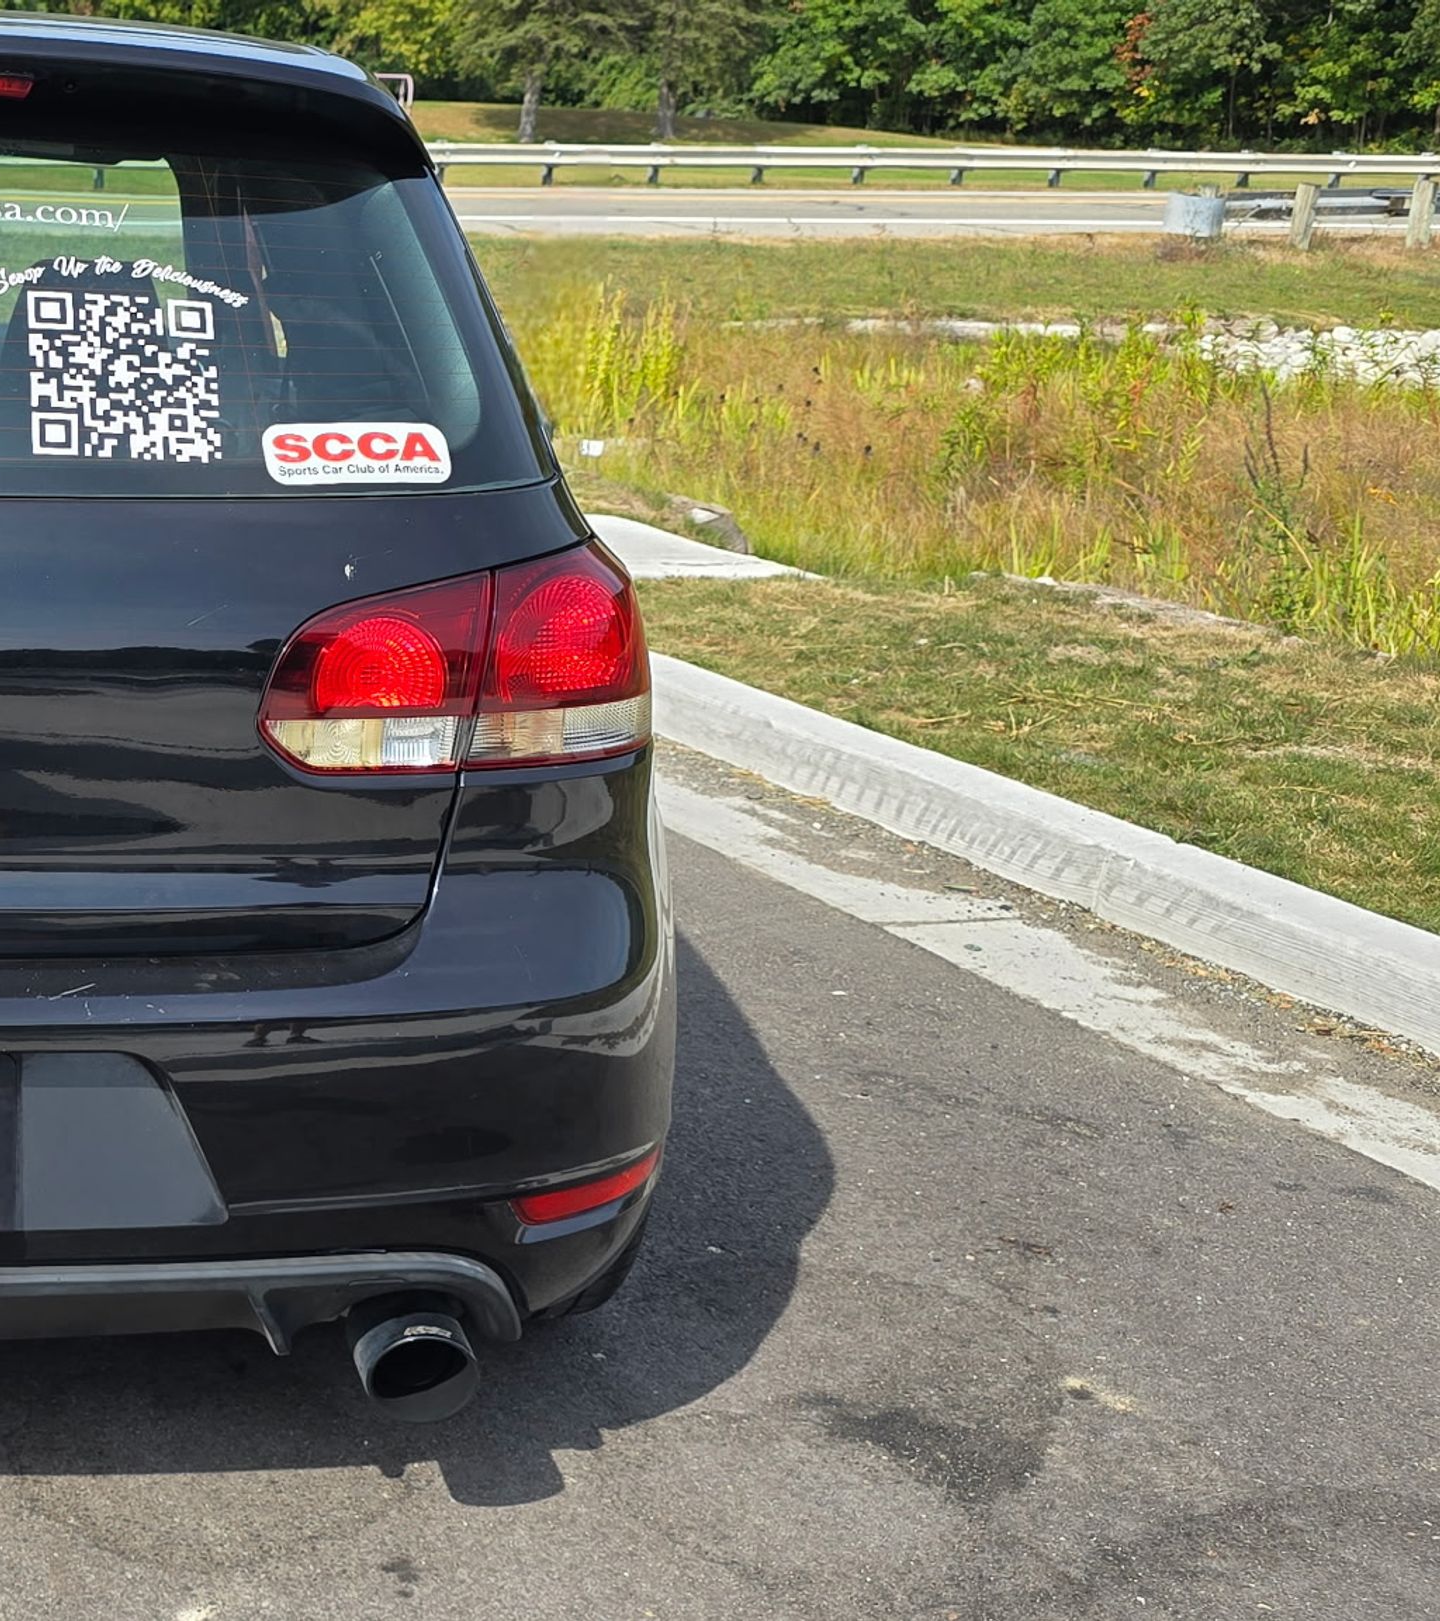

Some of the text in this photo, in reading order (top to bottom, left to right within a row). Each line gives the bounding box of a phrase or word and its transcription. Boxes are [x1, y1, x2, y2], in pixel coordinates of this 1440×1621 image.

[53, 256, 88, 278] Up
[94, 255, 123, 275] the
[132, 259, 249, 308] Deliciousness
[272, 431, 441, 463] SCCA
[278, 464, 319, 477] Sports
[322, 464, 343, 475] Car
[347, 463, 375, 474] Club
[378, 463, 390, 474] of
